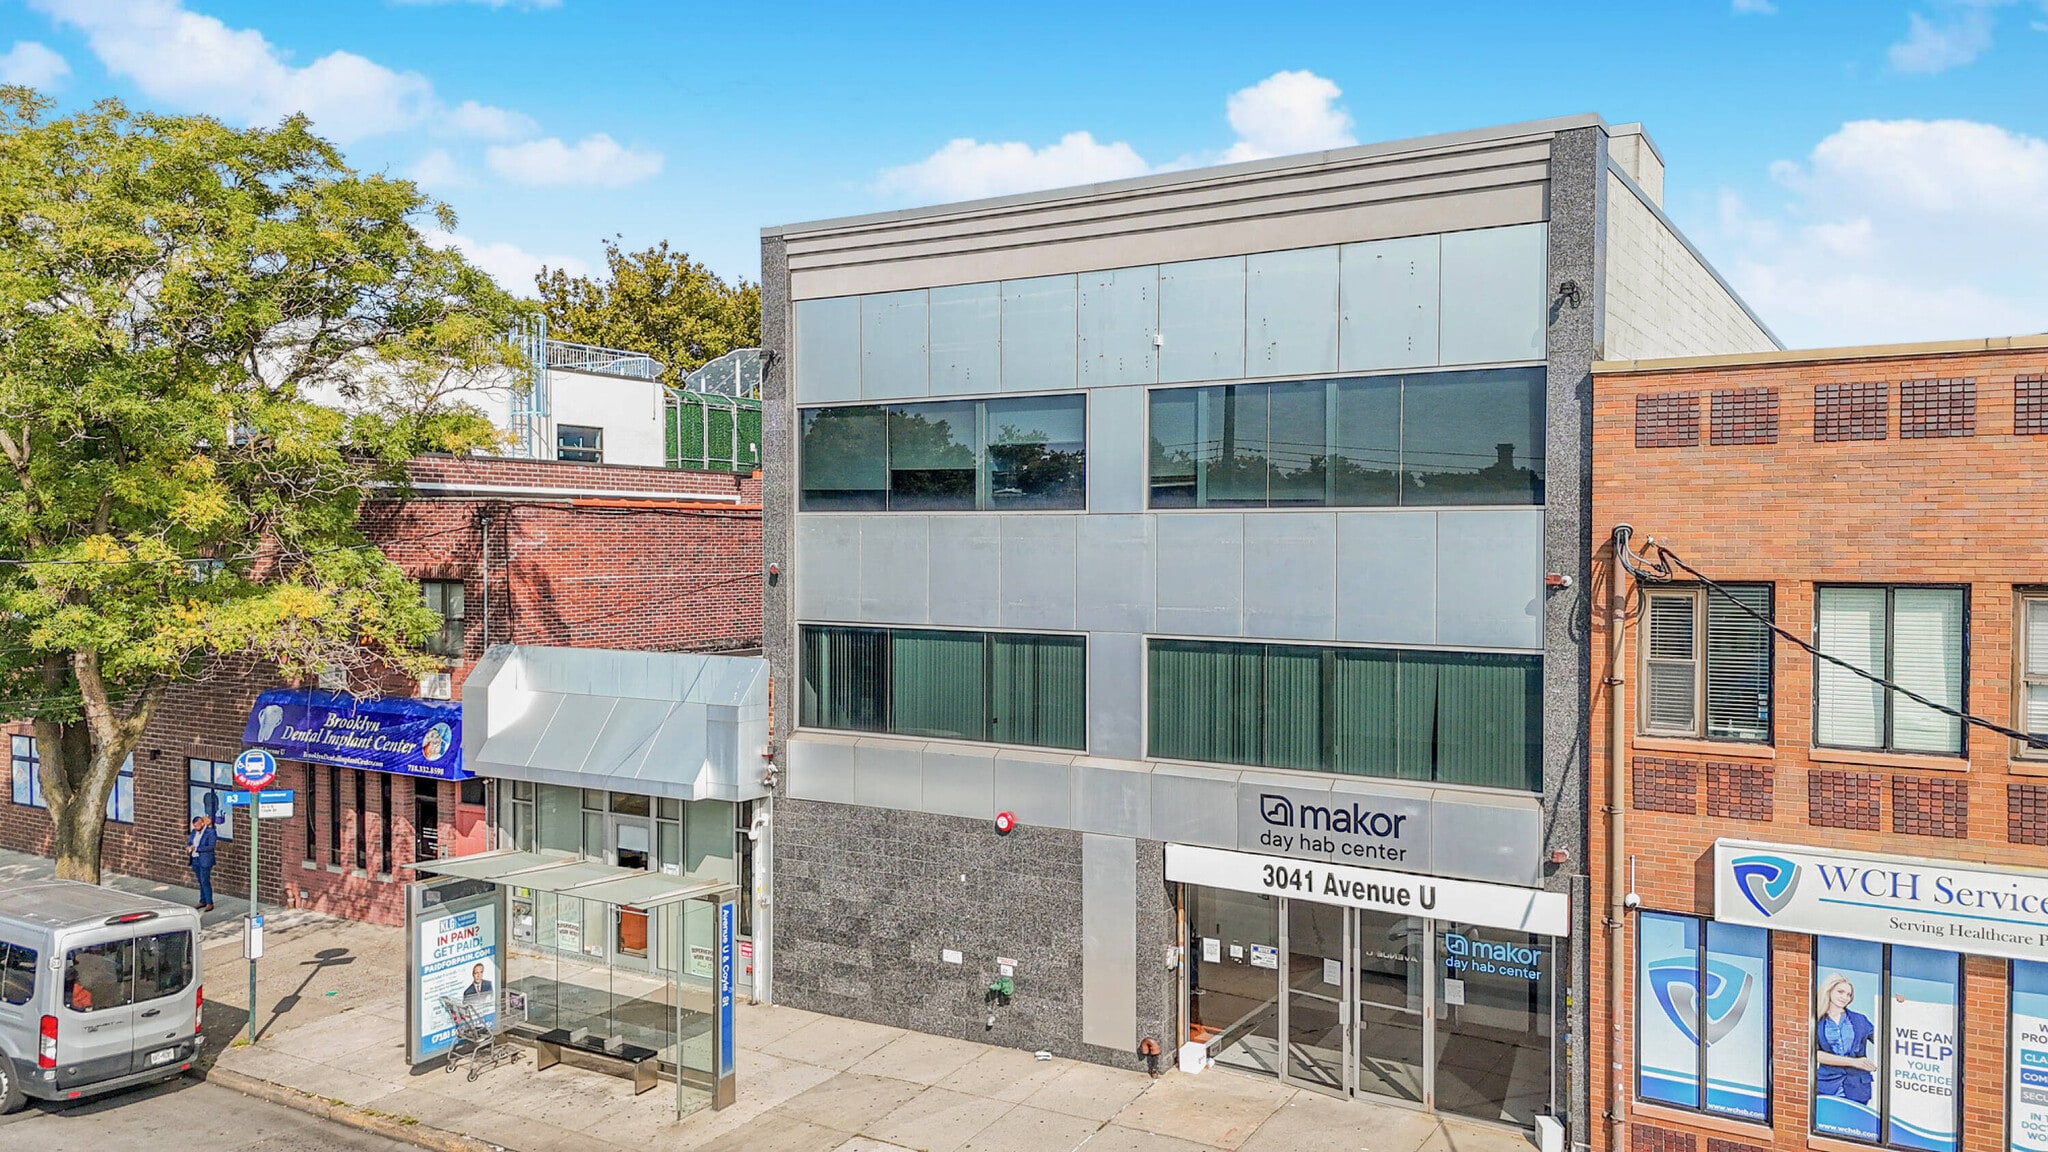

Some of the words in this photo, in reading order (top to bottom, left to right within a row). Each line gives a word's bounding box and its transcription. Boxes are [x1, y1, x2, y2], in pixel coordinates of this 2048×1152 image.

[324, 712, 380, 733] Brooklyn
[282, 725, 322, 744] Dental
[322, 730, 372, 751] Implant
[374, 737, 416, 754] Center
[1300, 803, 1406, 838] makor
[1260, 830, 1294, 852] day
[1300, 834, 1335, 853] hab
[1342, 842, 1407, 862] center
[1263, 864, 1313, 892] 3041
[1324, 872, 1410, 906] Avenue
[1420, 884, 1436, 910] U
[1815, 864, 1921, 900] WCH
[438, 934, 448, 946] IN
[451, 926, 480, 942] PAIN?
[1889, 916, 1944, 937] Serving
[1950, 924, 2033, 946] Healthcare
[434, 944, 455, 959] GET
[456, 936, 483, 952] PAID!
[722, 945, 730, 954] U
[1472, 940, 1542, 966] makor
[424, 947, 490, 974] PAIDFORPAIN.COM
[1445, 956, 1469, 972] day
[1472, 958, 1496, 974] hab
[1499, 965, 1542, 981] center
[722, 996, 730, 1008] St
[1896, 1027, 1918, 1040] WE
[1923, 1032, 1952, 1045] CAN
[1895, 1040, 1953, 1061] HELP
[1908, 1060, 1940, 1073] YOUR
[1895, 1069, 1952, 1086] PRACTICE
[1895, 1080, 1953, 1097] SUCCEED
[1707, 1103, 1765, 1119] www.wchsb.com
[2030, 1112, 2041, 1121] IN
[1817, 1122, 1878, 1139] www.wchsb.com
[2021, 1121, 2048, 1132] DOC
